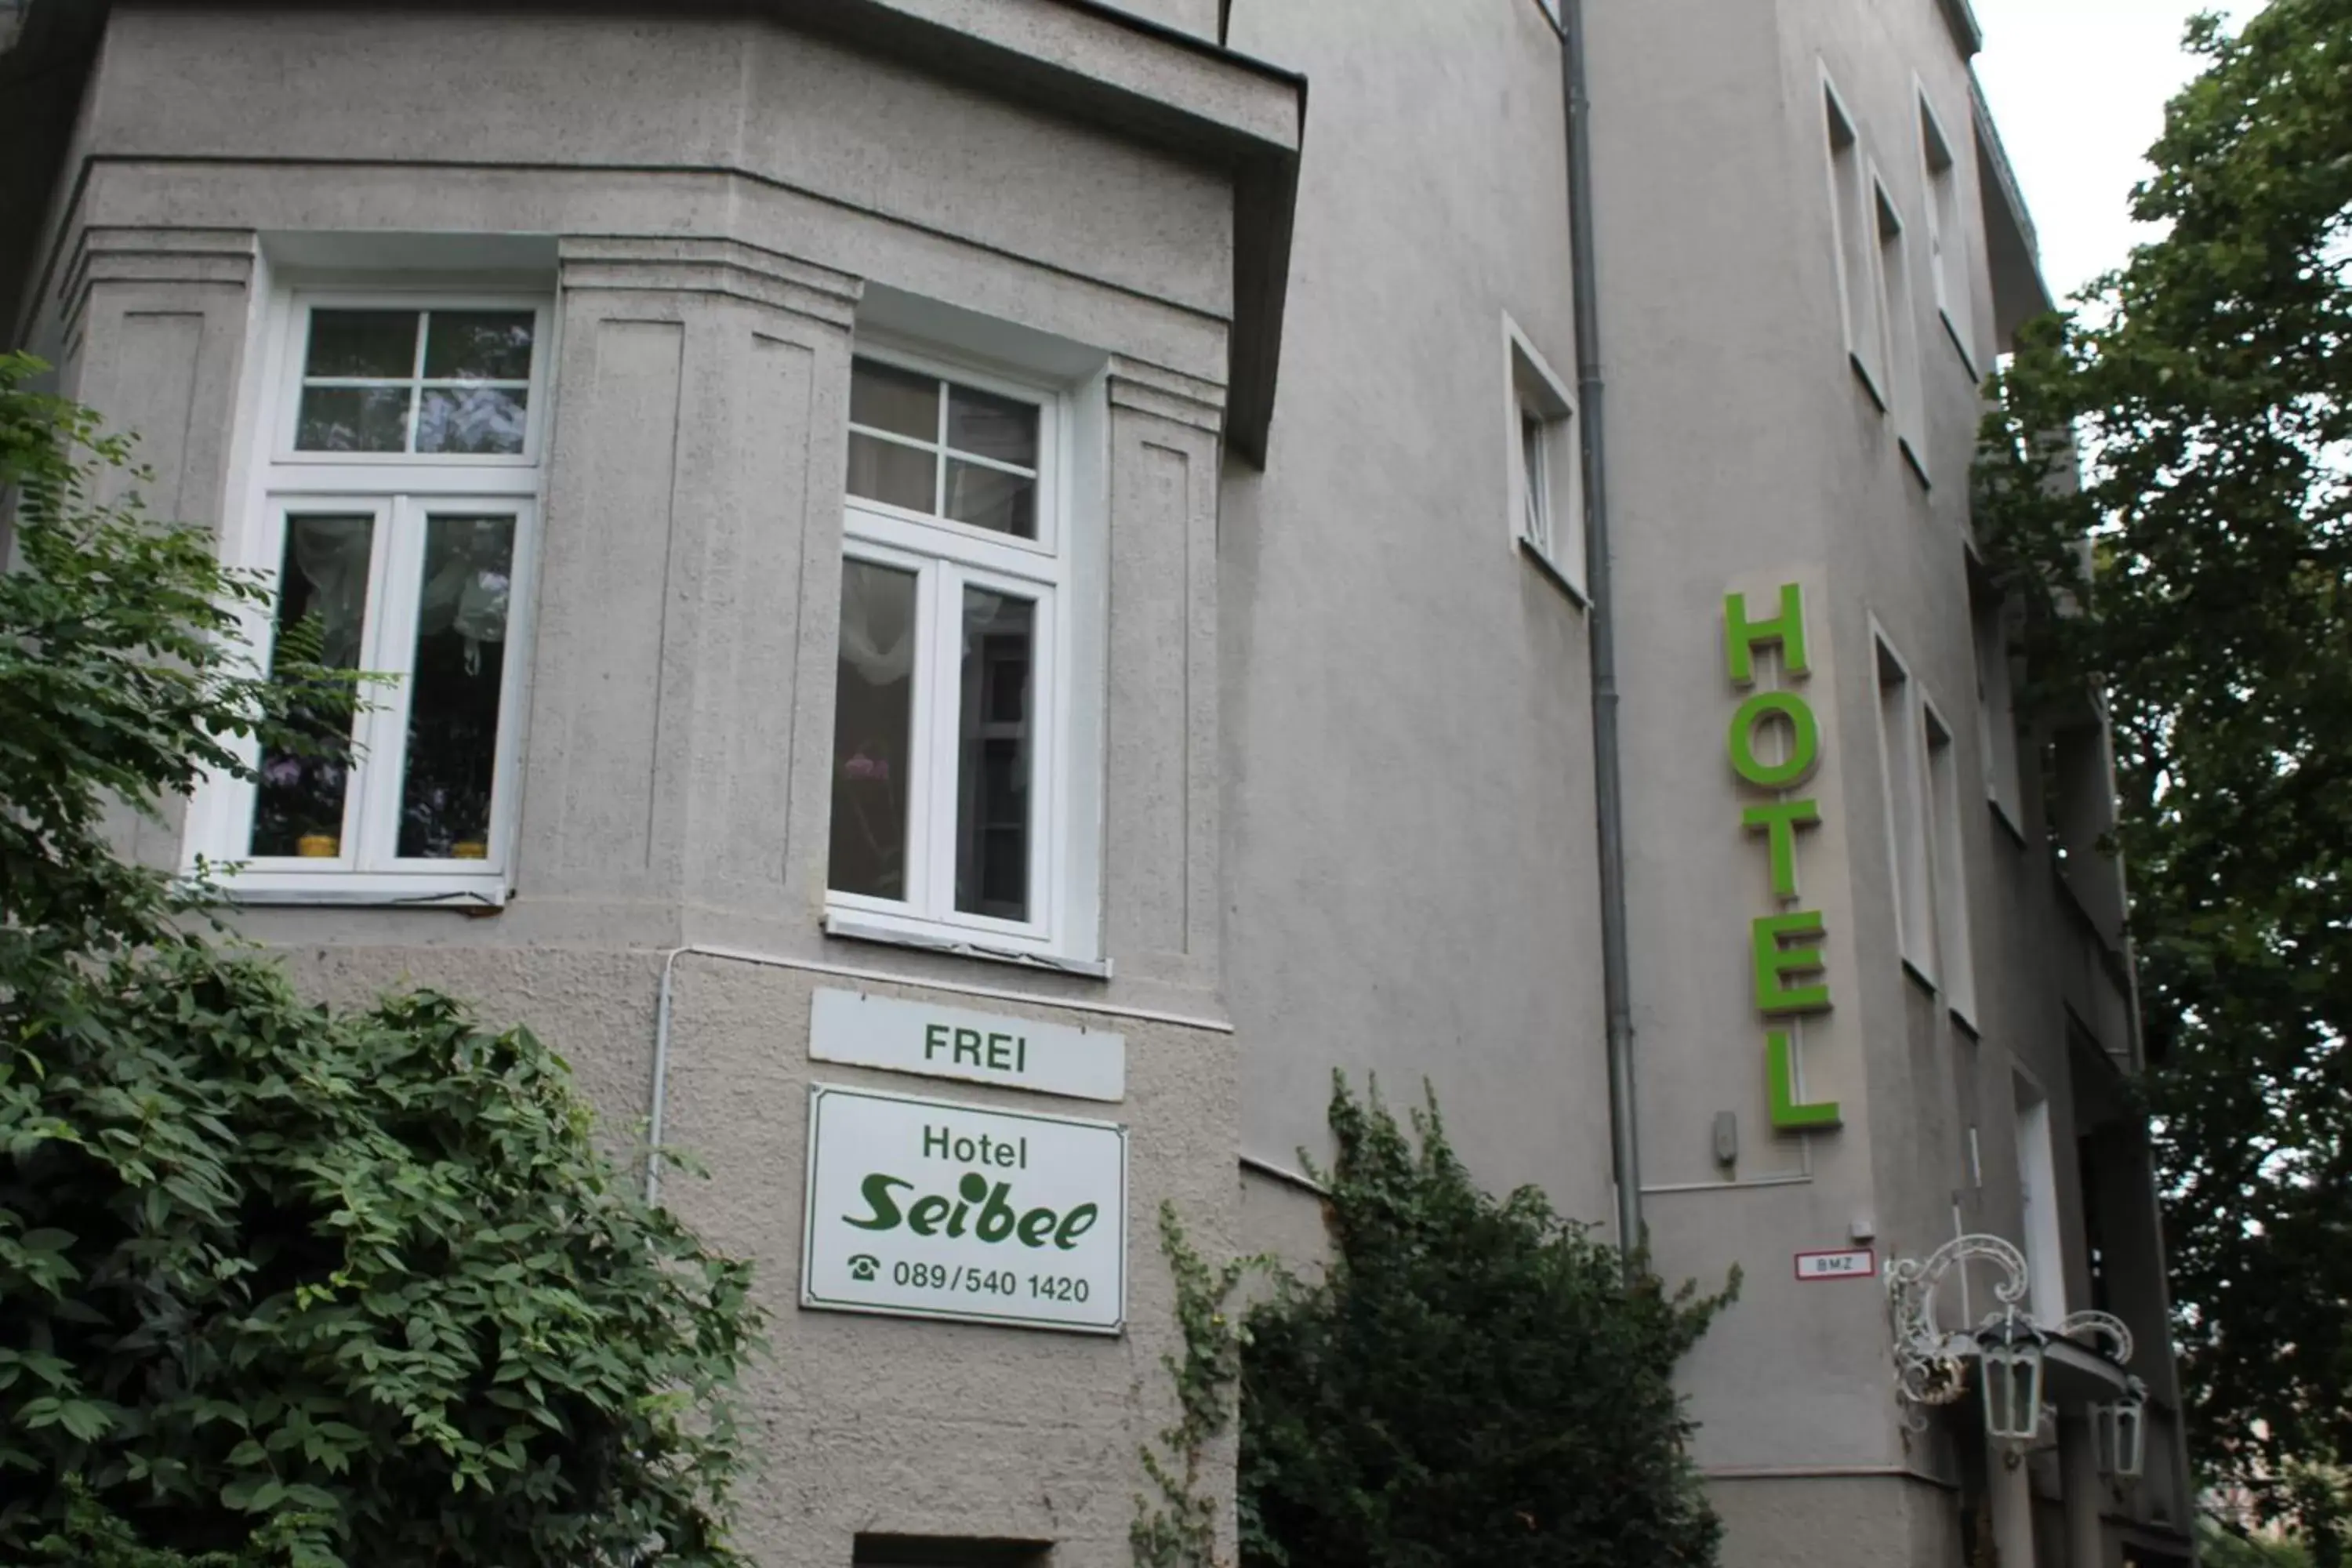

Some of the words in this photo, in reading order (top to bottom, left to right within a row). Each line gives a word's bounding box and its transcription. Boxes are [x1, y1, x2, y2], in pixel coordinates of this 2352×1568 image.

[1725, 583, 1840, 1128] HOTEL
[924, 1024, 1025, 1073] FREI
[923, 1124, 1025, 1169] Hotel
[841, 1172, 1098, 1250] Seibel
[893, 1261, 1017, 1296] 089/540
[1028, 1275, 1090, 1302] 1420
